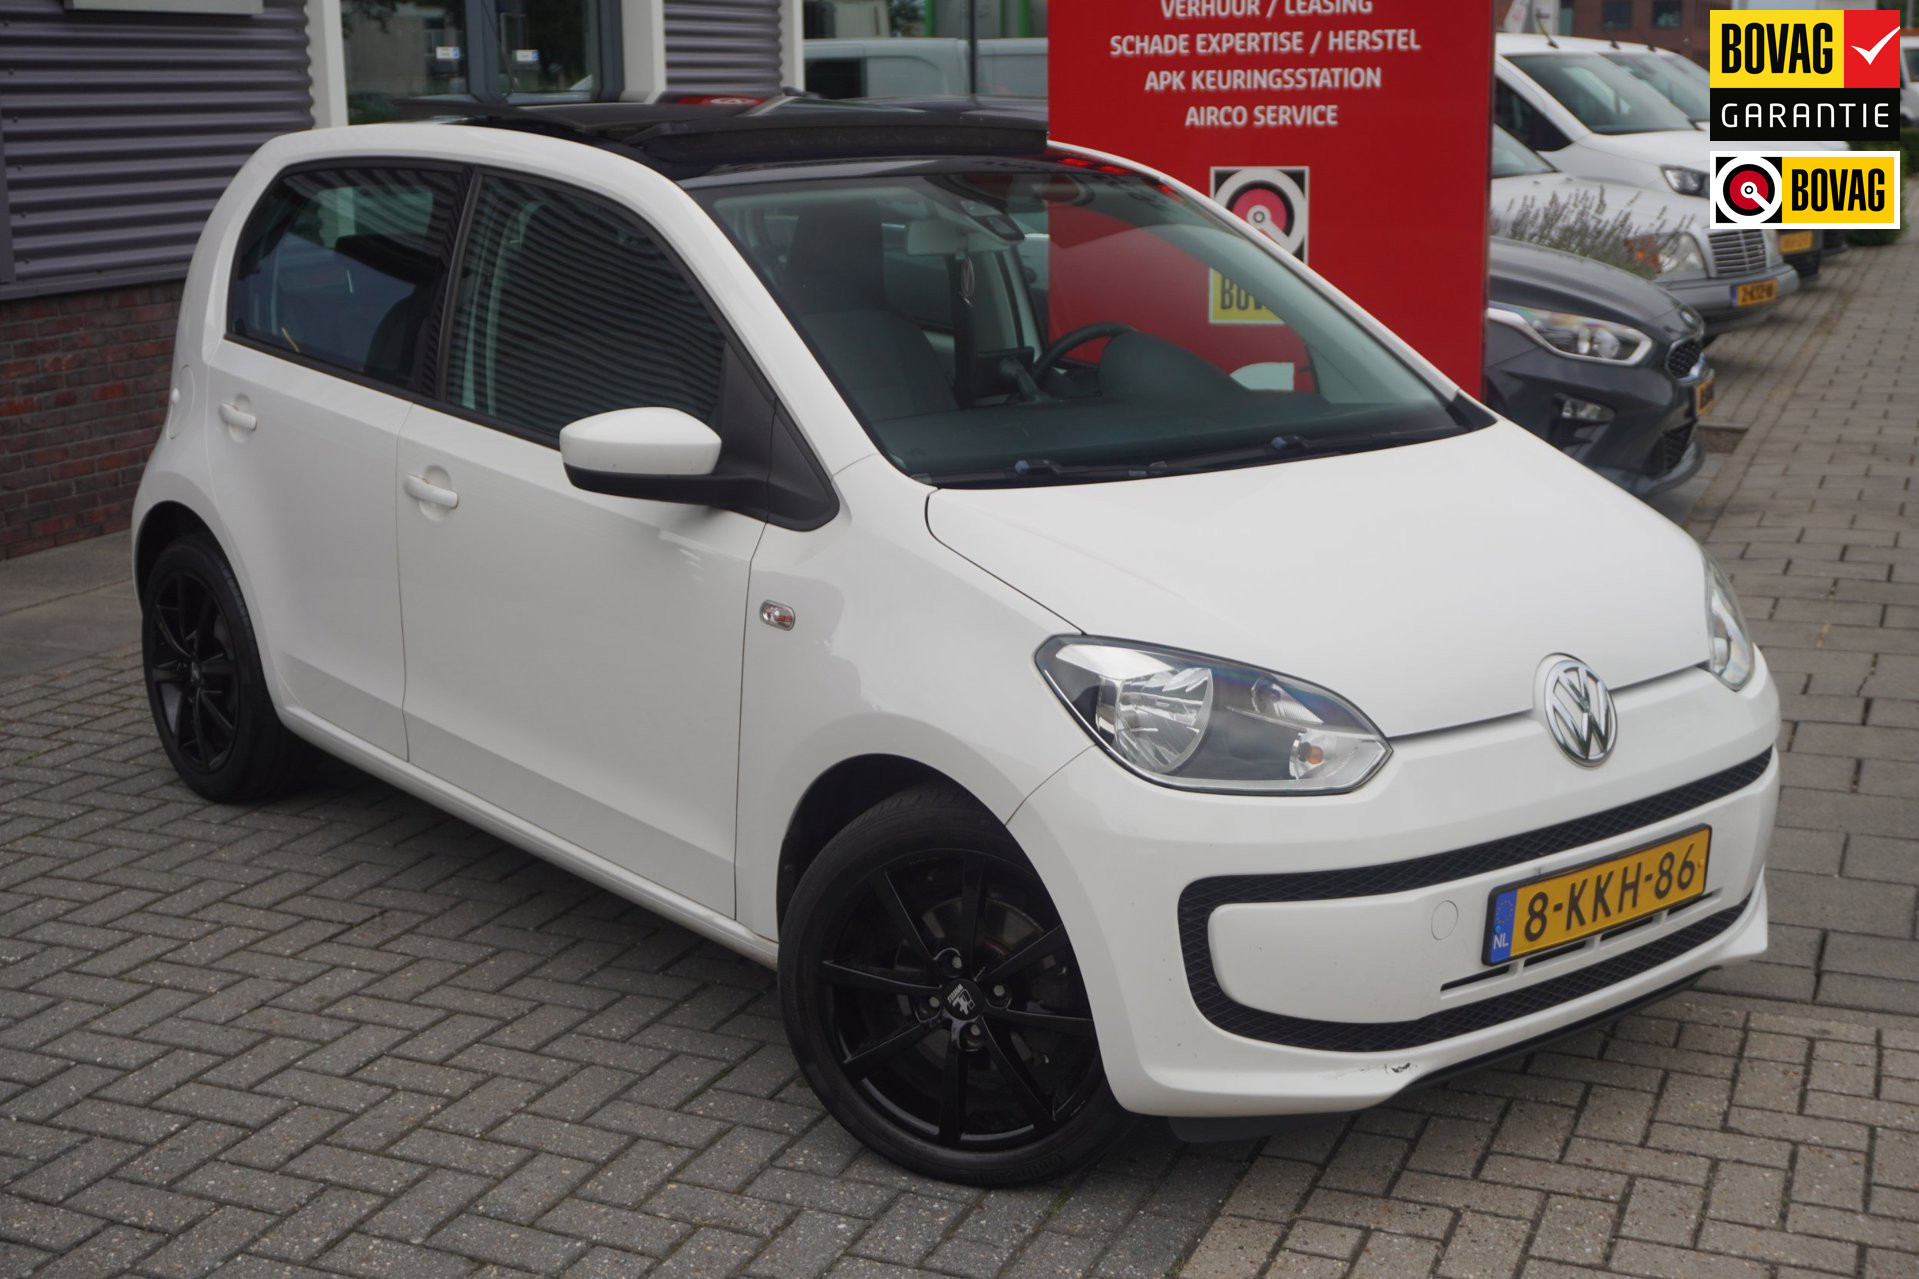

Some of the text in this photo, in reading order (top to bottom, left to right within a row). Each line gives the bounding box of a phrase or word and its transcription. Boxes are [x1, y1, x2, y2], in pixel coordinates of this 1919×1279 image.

[1161, 0, 1373, 18] VERHUUR / LEASING
[1110, 29, 1421, 56] SCHADE EXPERTISE / HERSTEL
[1144, 67, 1381, 90] APK KEURINGSSTATION
[1185, 105, 1338, 126] AIRCO SERVICE
[1524, 843, 1695, 942] 8-KKH-86
[1492, 931, 1509, 951] NL
